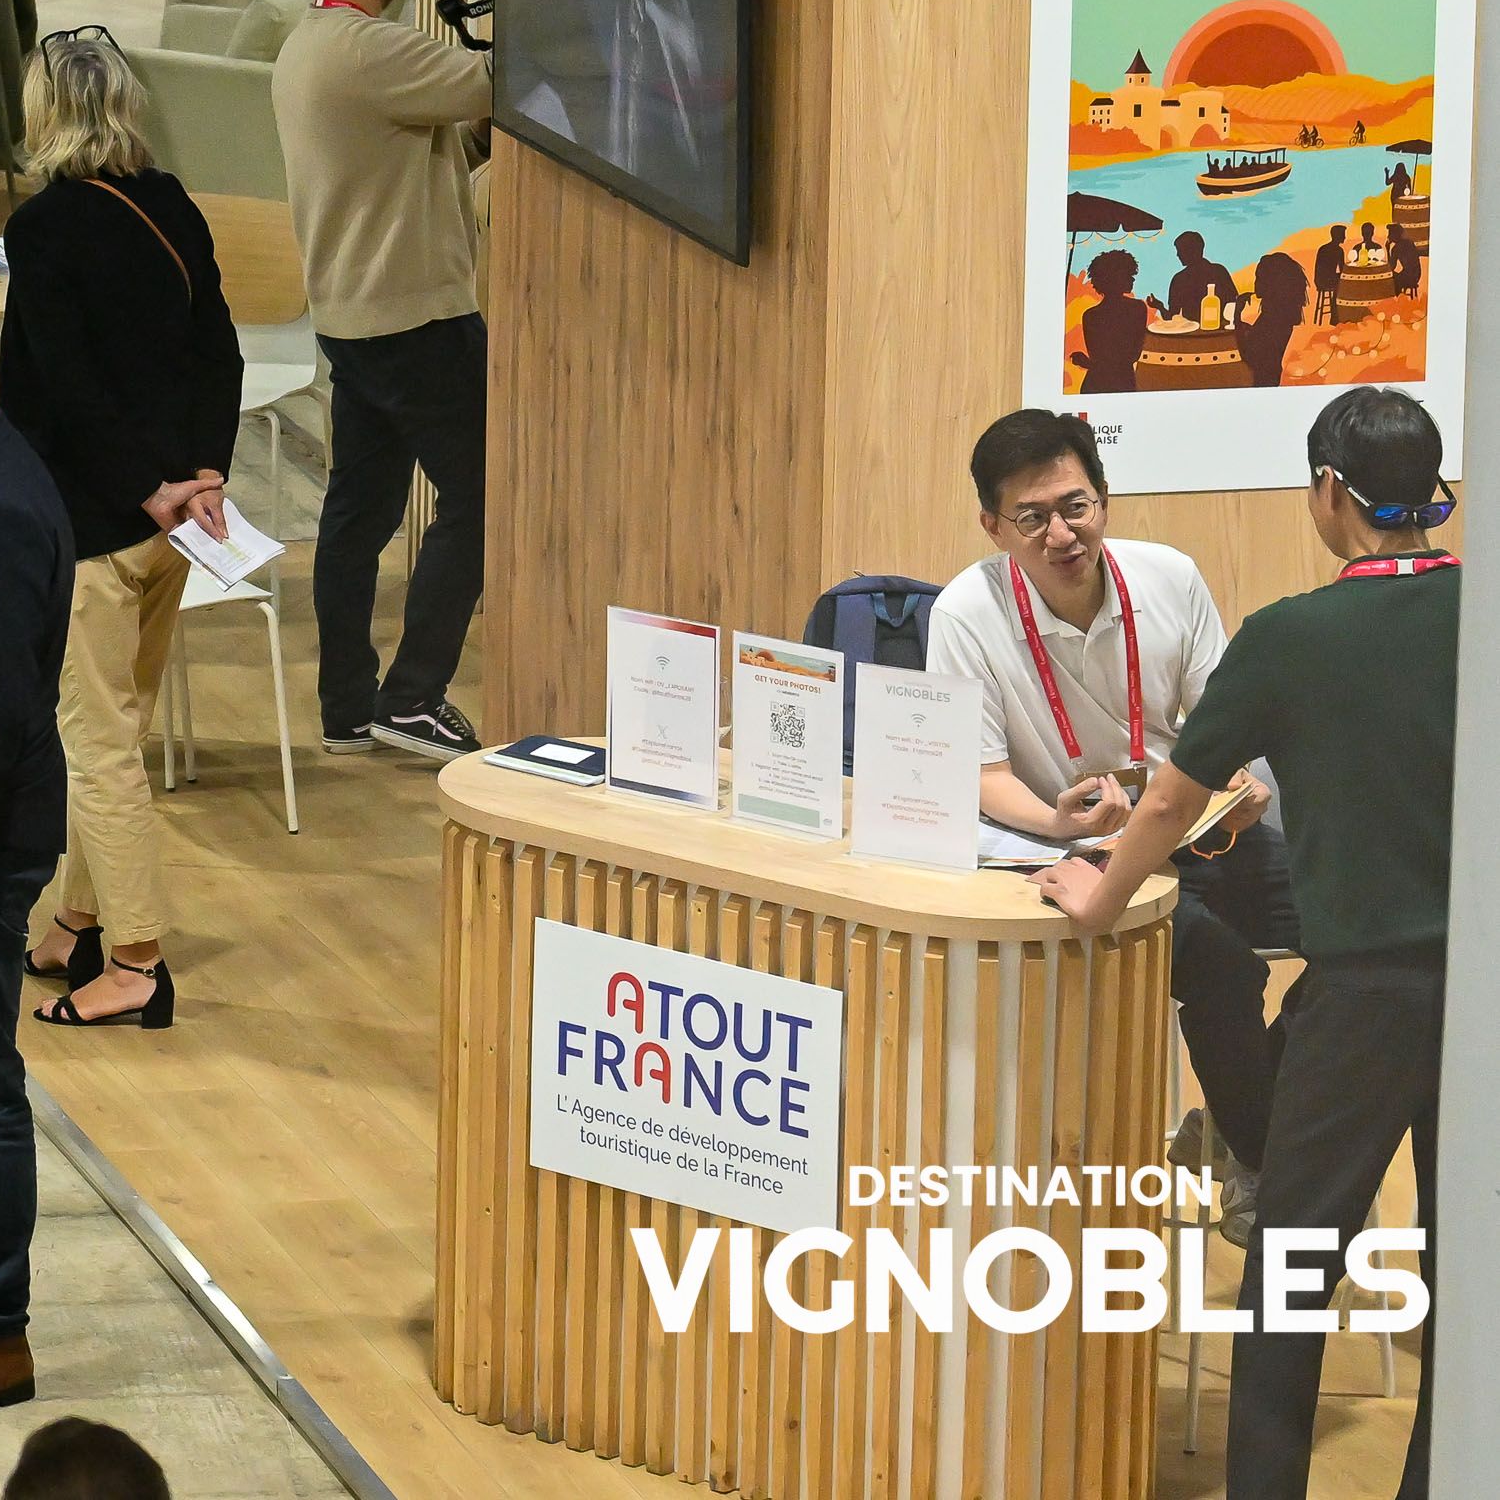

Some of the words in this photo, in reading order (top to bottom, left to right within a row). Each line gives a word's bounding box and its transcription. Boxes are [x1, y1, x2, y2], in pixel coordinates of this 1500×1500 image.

[1092, 424, 1123, 435] LIQUE
[769, 677, 789, 688] YOUR
[789, 680, 821, 694] PHOTOS!
[885, 684, 951, 703] VIGNOBLES
[607, 971, 813, 1072] ATOUT
[557, 1020, 810, 1139] FRANCE
[570, 1098, 636, 1131] Agence
[641, 1117, 664, 1137] de
[668, 1125, 808, 1176] développement
[580, 1126, 671, 1165] touristique
[676, 1151, 699, 1172] de
[704, 1157, 719, 1178] la
[724, 1167, 783, 1195] France
